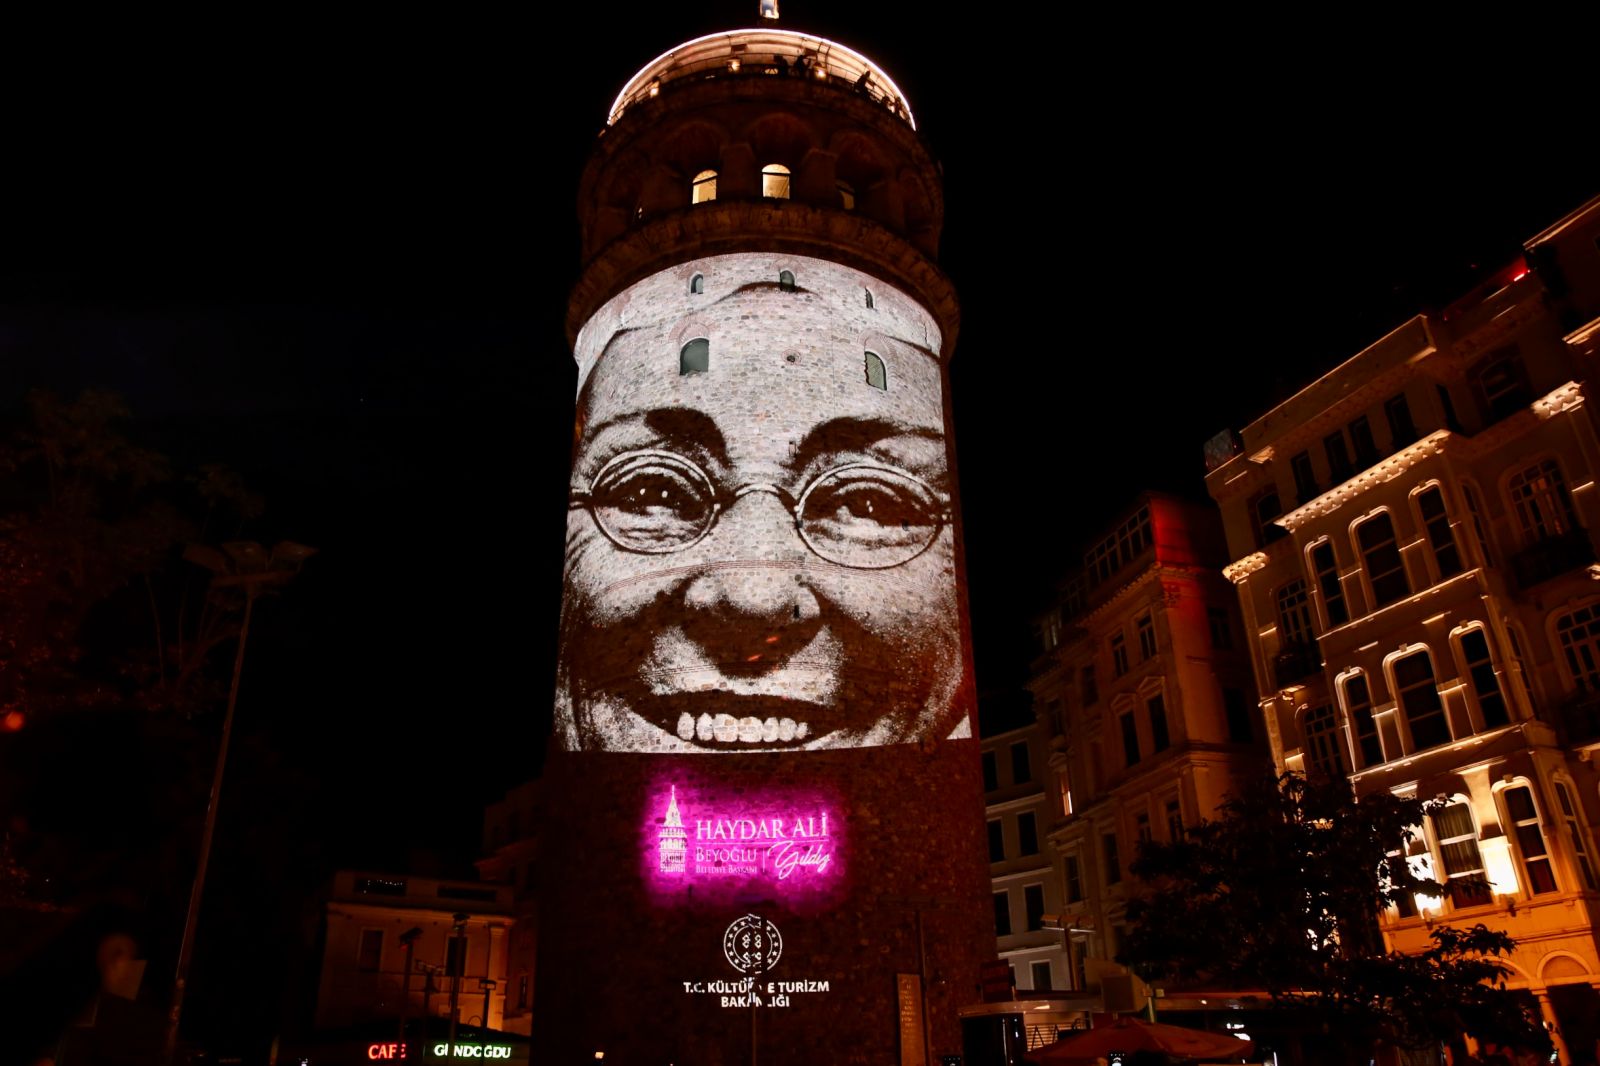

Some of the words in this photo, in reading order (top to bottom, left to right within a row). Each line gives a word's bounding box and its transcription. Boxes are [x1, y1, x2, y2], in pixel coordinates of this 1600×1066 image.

[696, 819, 787, 840] HAYDAR
[792, 812, 830, 837] ALİ
[696, 847, 758, 863] BEYOĞLU
[683, 982, 706, 993] T.C.
[778, 980, 830, 993] TURİZM
